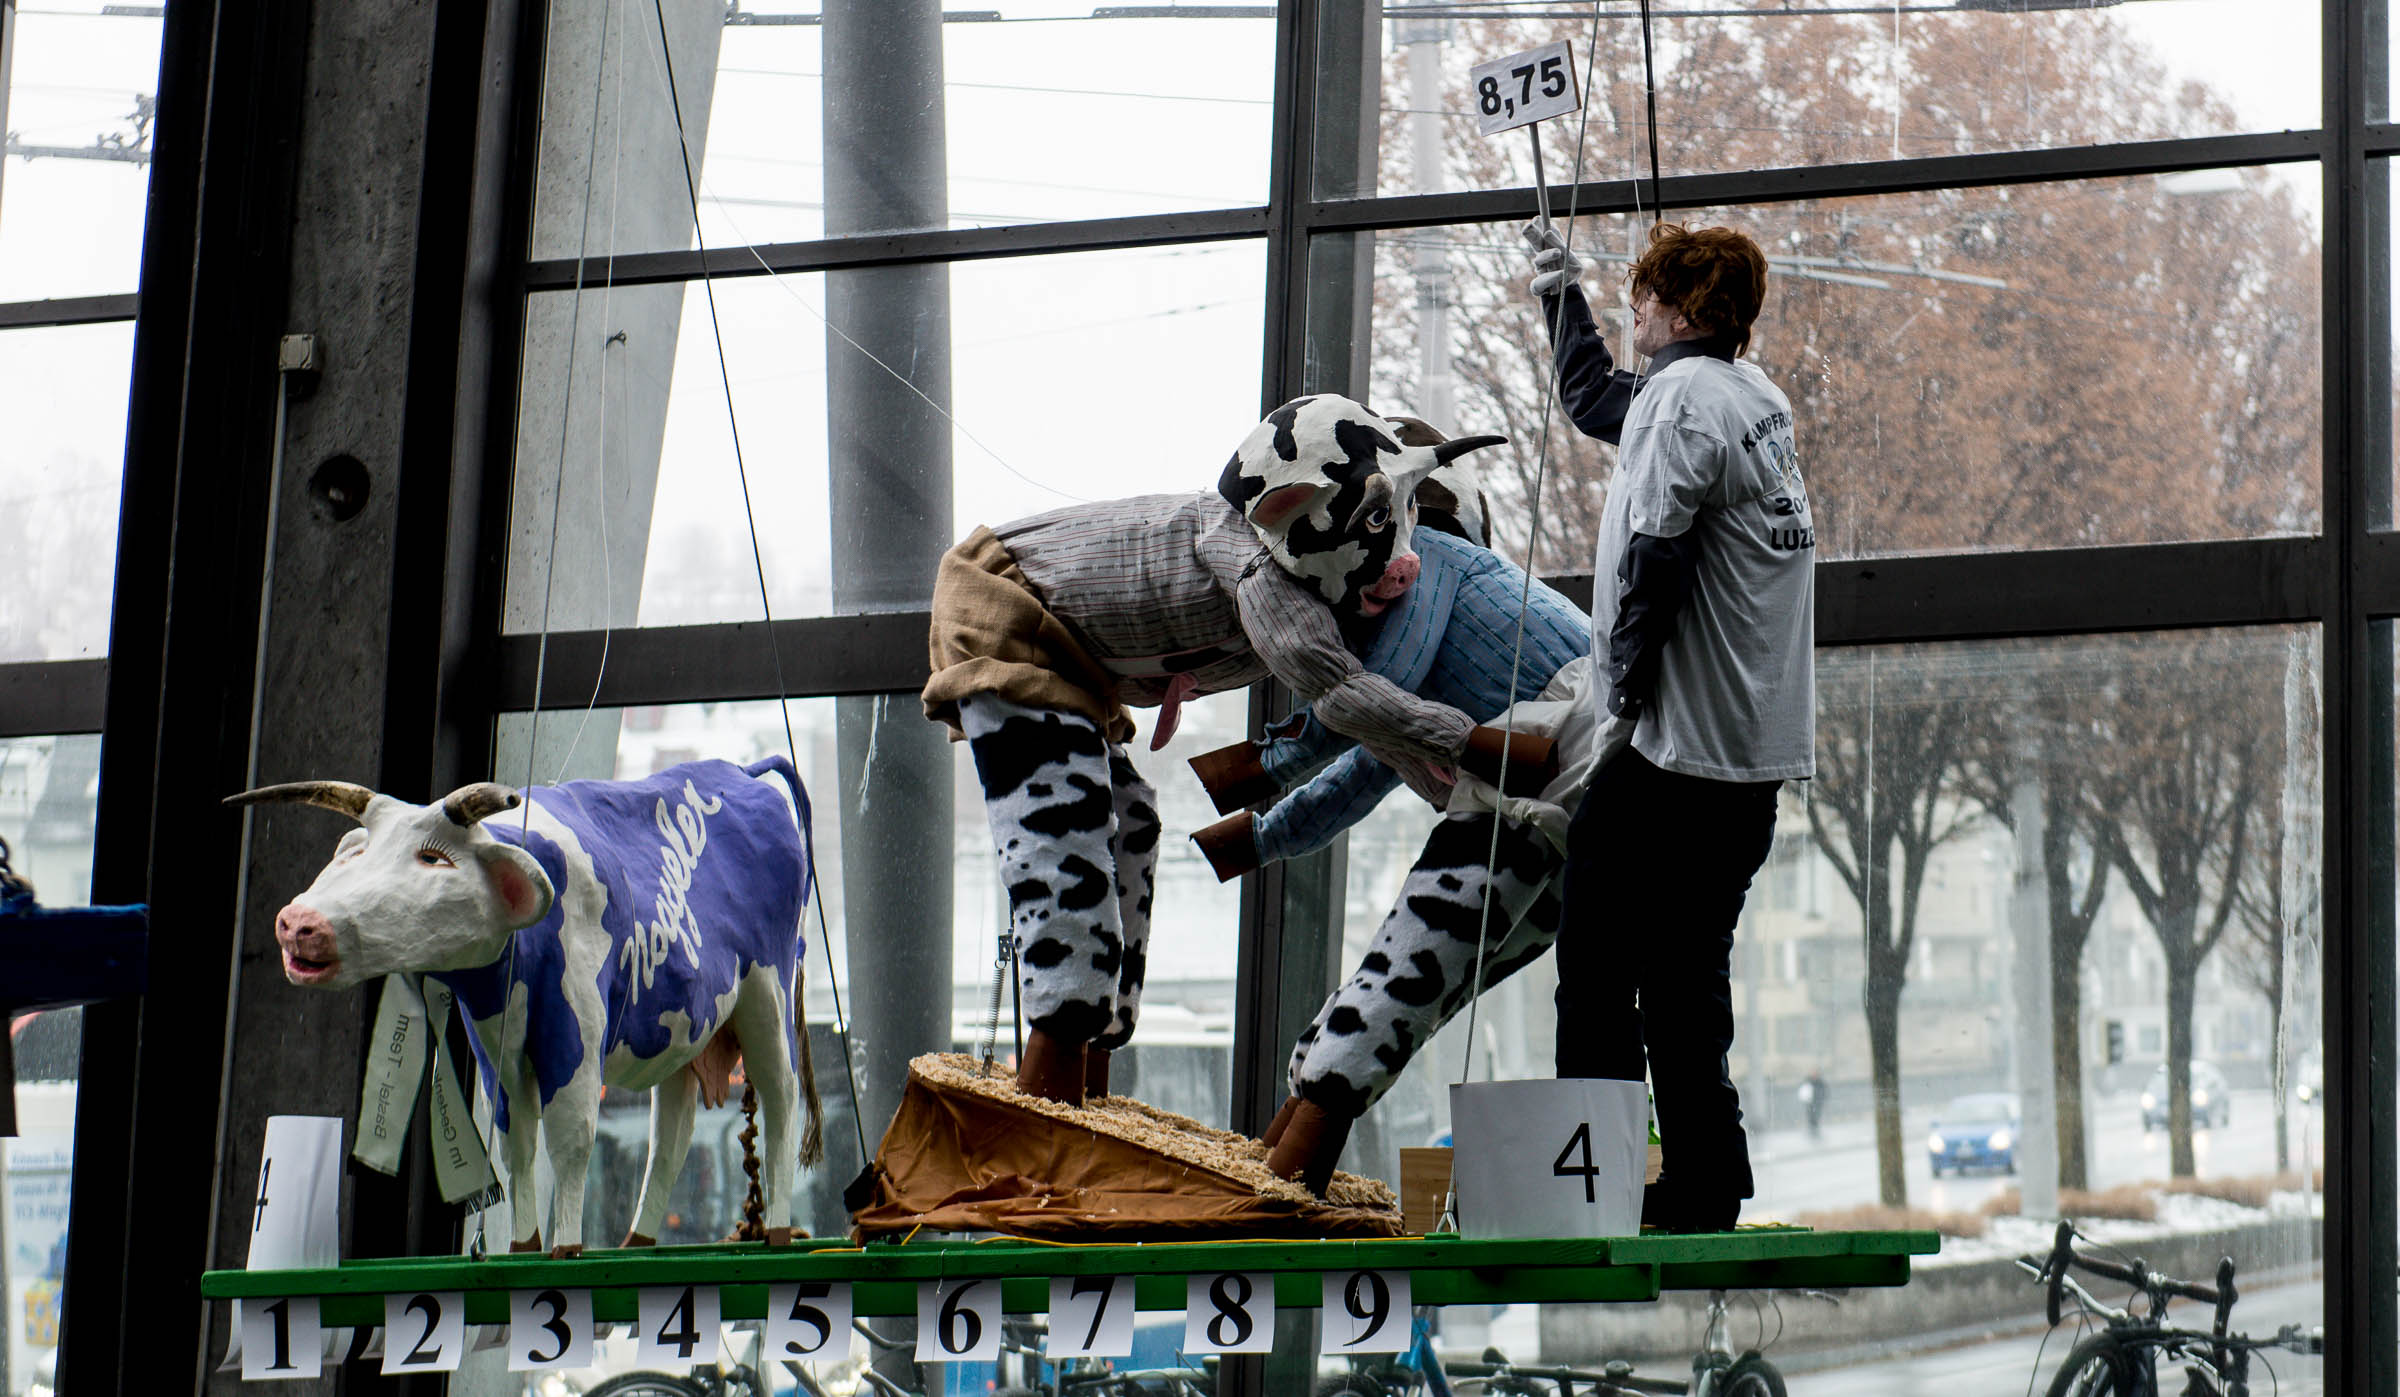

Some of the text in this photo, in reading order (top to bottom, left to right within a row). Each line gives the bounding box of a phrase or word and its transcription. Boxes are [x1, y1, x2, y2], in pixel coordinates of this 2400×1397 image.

[1478, 56, 1566, 120] 8,75
[1553, 1122, 1600, 1203] 4
[263, 1299, 298, 1370] 1
[400, 1293, 443, 1366] 2
[527, 1289, 572, 1363] 3
[657, 1285, 701, 1359] 4
[785, 1284, 832, 1354] 5
[938, 1280, 982, 1354] 6
[1069, 1276, 1116, 1351] 7
[1206, 1272, 1254, 1348] 8
[1342, 1269, 1391, 1348] 9
